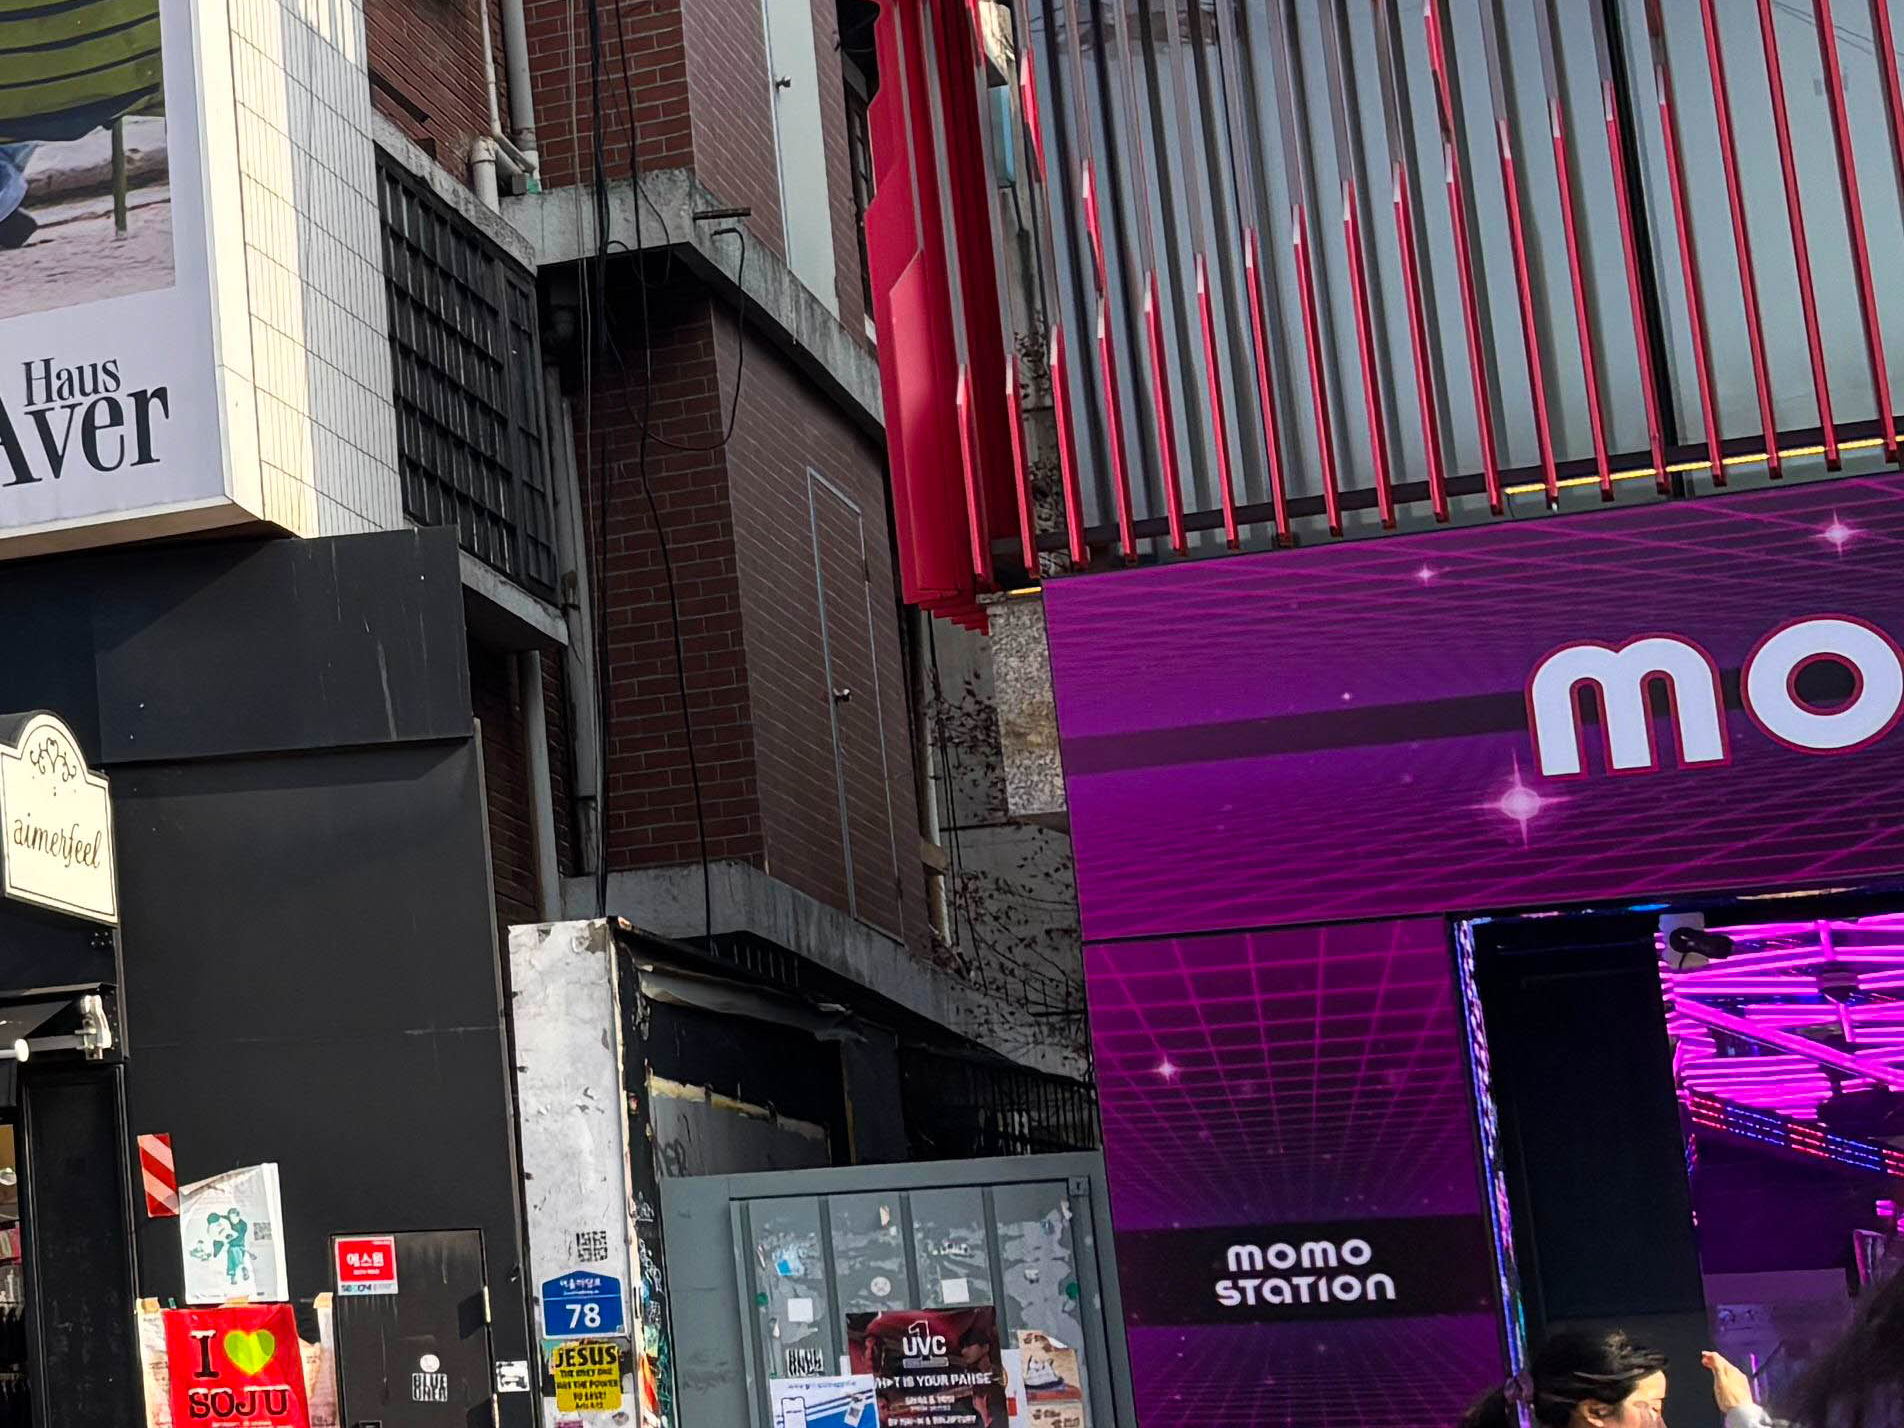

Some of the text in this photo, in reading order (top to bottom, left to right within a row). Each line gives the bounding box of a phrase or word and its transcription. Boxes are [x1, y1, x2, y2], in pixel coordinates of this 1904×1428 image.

[23, 357, 121, 407] Haus
[13, 813, 103, 870] aimerfeel
[565, 1302, 602, 1330] 78
[190, 1329, 220, 1379] I
[554, 1345, 618, 1369] JESUS
[902, 1335, 948, 1357] UVC
[188, 1384, 291, 1419] SOJU
